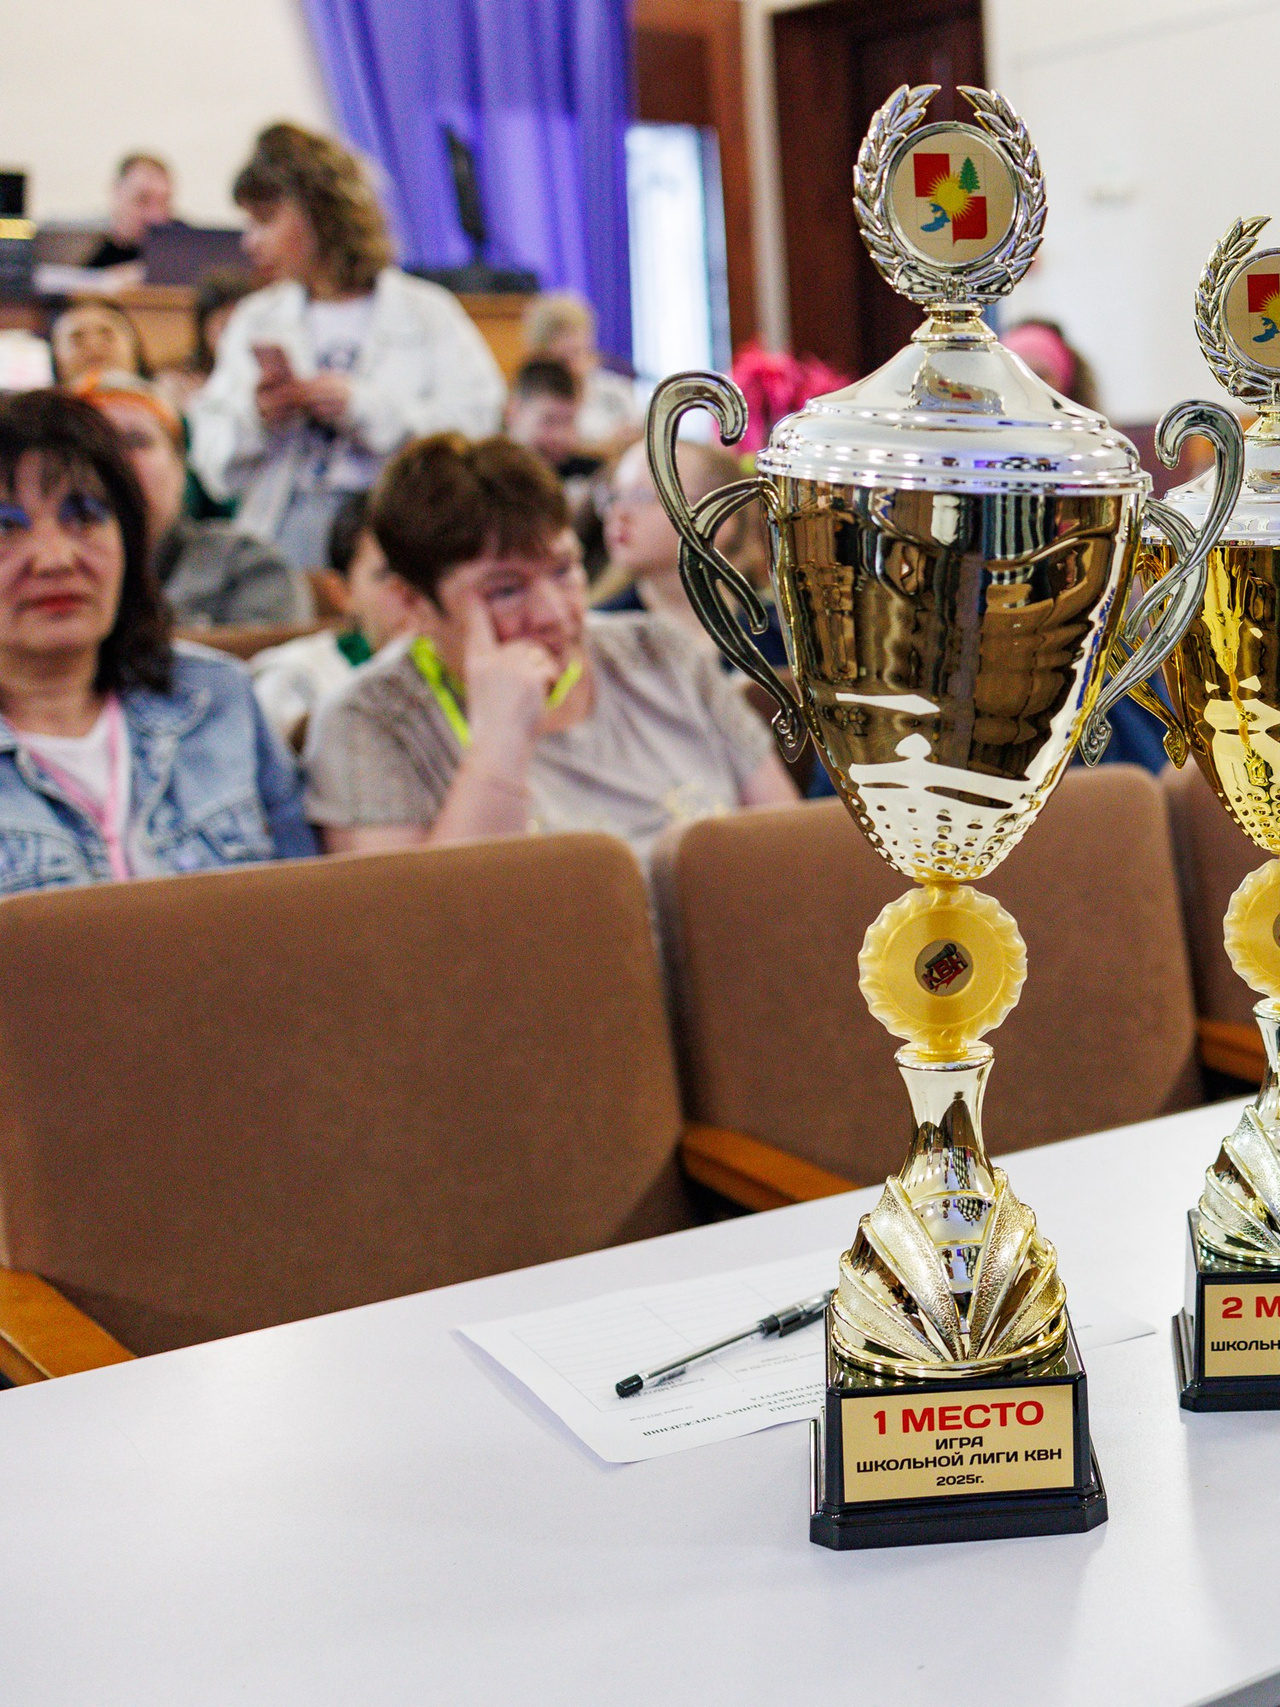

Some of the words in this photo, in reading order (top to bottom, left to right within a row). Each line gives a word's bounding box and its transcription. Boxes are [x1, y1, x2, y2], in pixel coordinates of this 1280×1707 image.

[1221, 1297, 1243, 1319] 2
[873, 1410, 886, 1435] 1
[902, 1400, 1044, 1434] МЕСТО
[935, 1436, 983, 1450] ИГРА
[856, 1452, 964, 1473] ШКОЛЬНОЙ
[969, 1451, 1019, 1465] ЛИГИ
[1024, 1448, 1062, 1462] КВН
[936, 1474, 984, 1486] 2025г.
